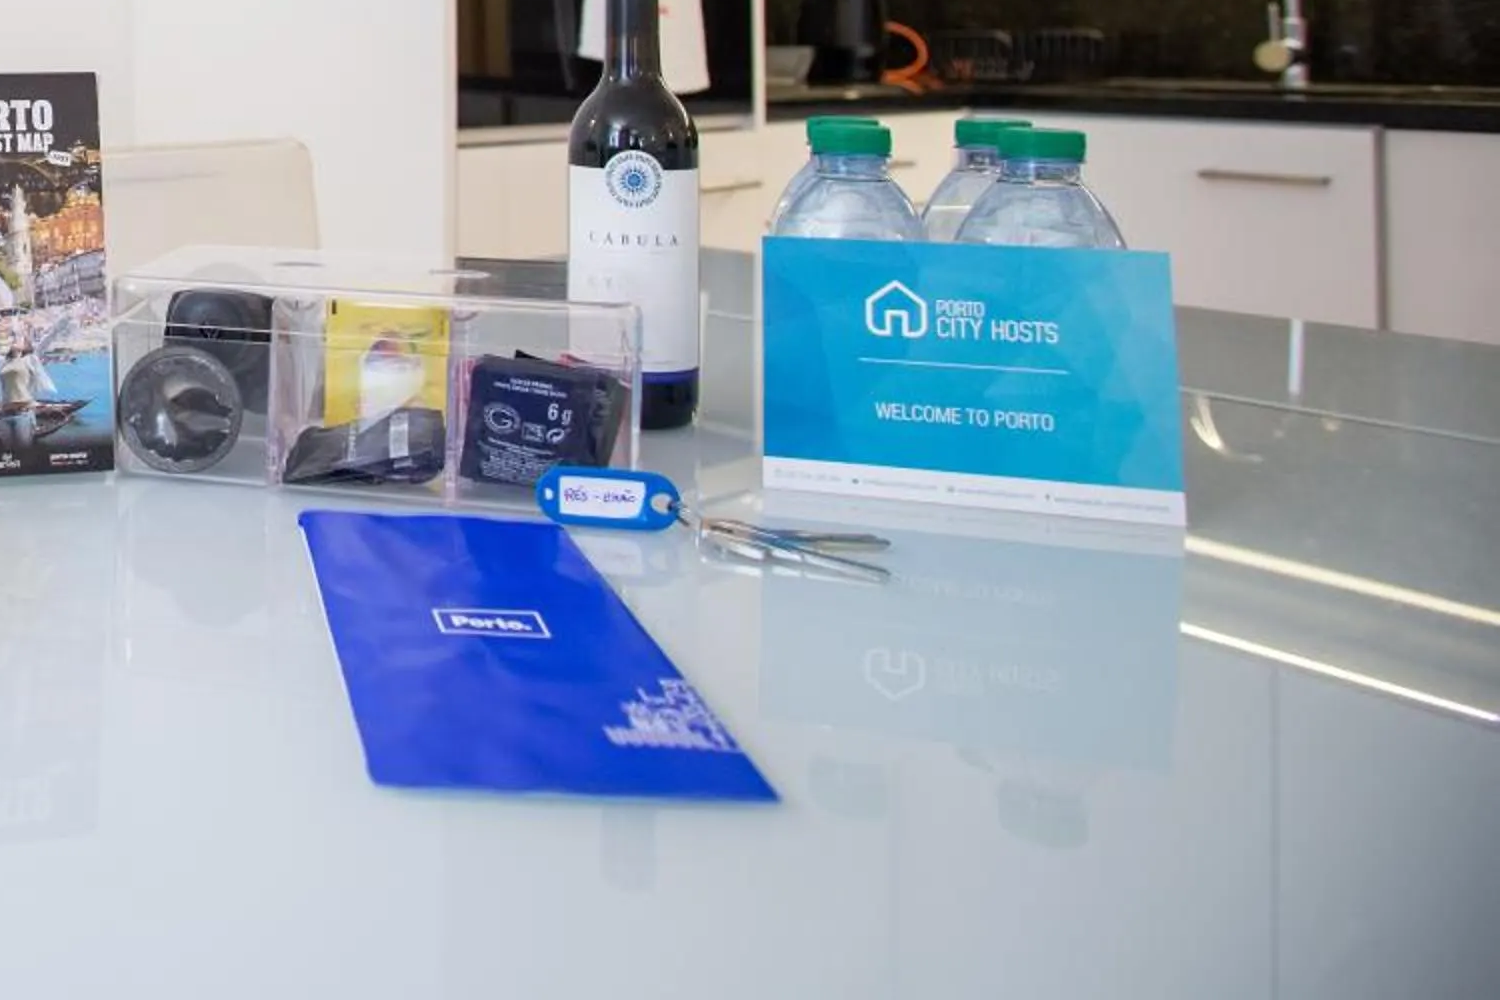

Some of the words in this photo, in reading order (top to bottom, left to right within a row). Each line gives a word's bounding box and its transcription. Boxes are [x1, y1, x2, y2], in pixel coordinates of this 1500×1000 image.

[17, 132, 54, 154] MAP
[936, 300, 985, 317] PORTO
[937, 317, 984, 340] CITY
[991, 320, 1059, 344] HOSTS
[547, 403, 559, 421] 6
[875, 402, 961, 425] WELCOME
[965, 407, 989, 427] TO
[994, 411, 1055, 432] PORTO
